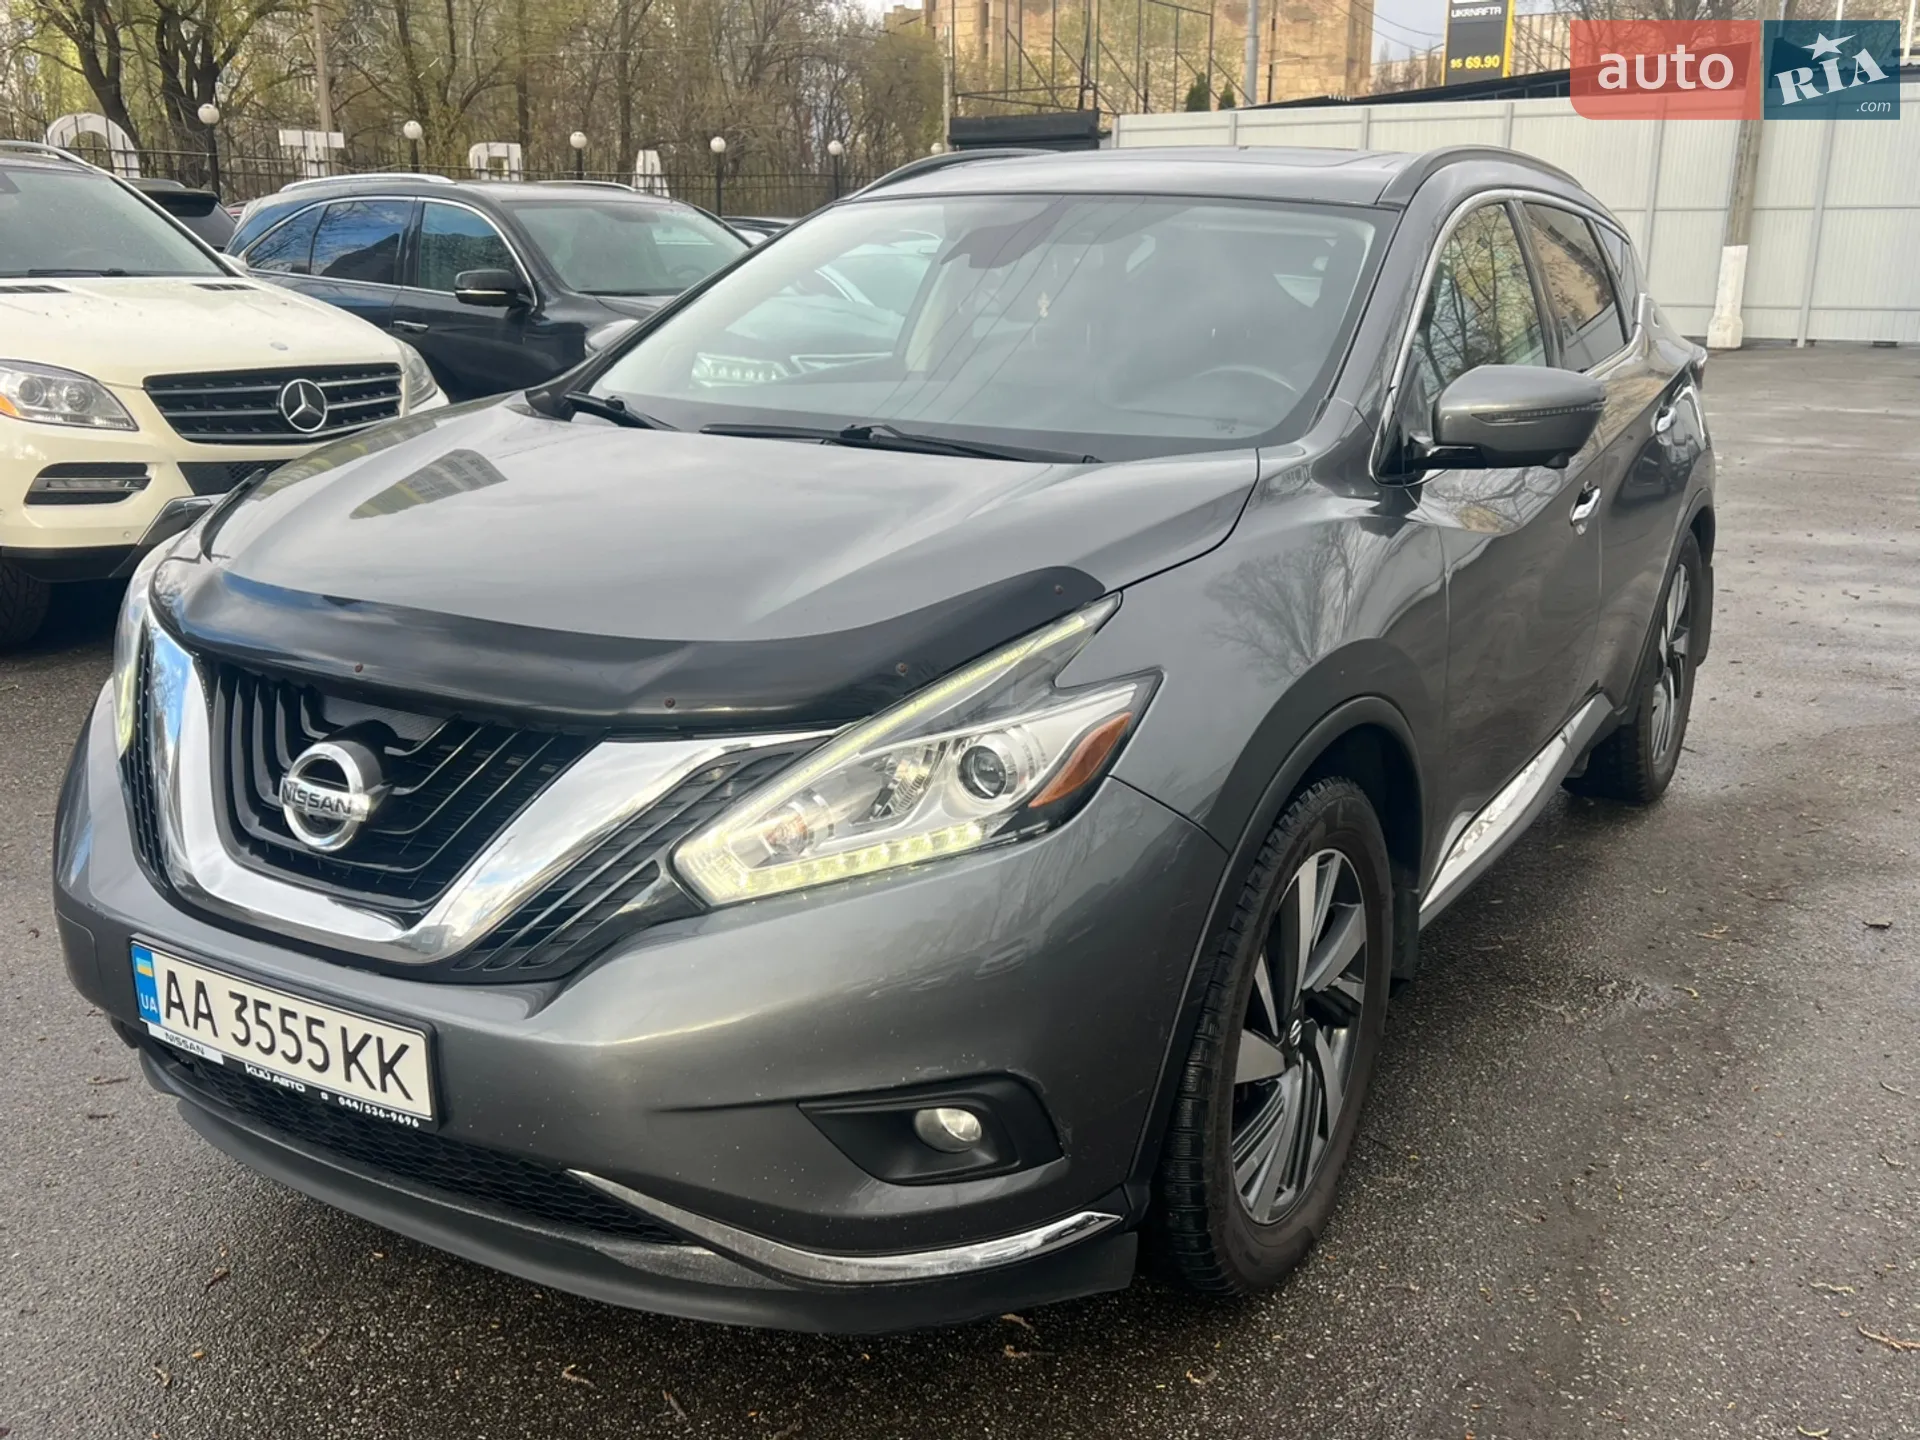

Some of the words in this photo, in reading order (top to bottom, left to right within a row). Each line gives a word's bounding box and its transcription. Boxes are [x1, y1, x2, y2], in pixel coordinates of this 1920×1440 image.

[1465, 55, 1500, 69] 69.90
[282, 780, 352, 815] NISSAN
[139, 992, 158, 1013] UA
[164, 1031, 206, 1057] NISSAN
[165, 969, 219, 1038] AA
[228, 990, 330, 1073] 3555
[340, 1025, 414, 1101] KK
